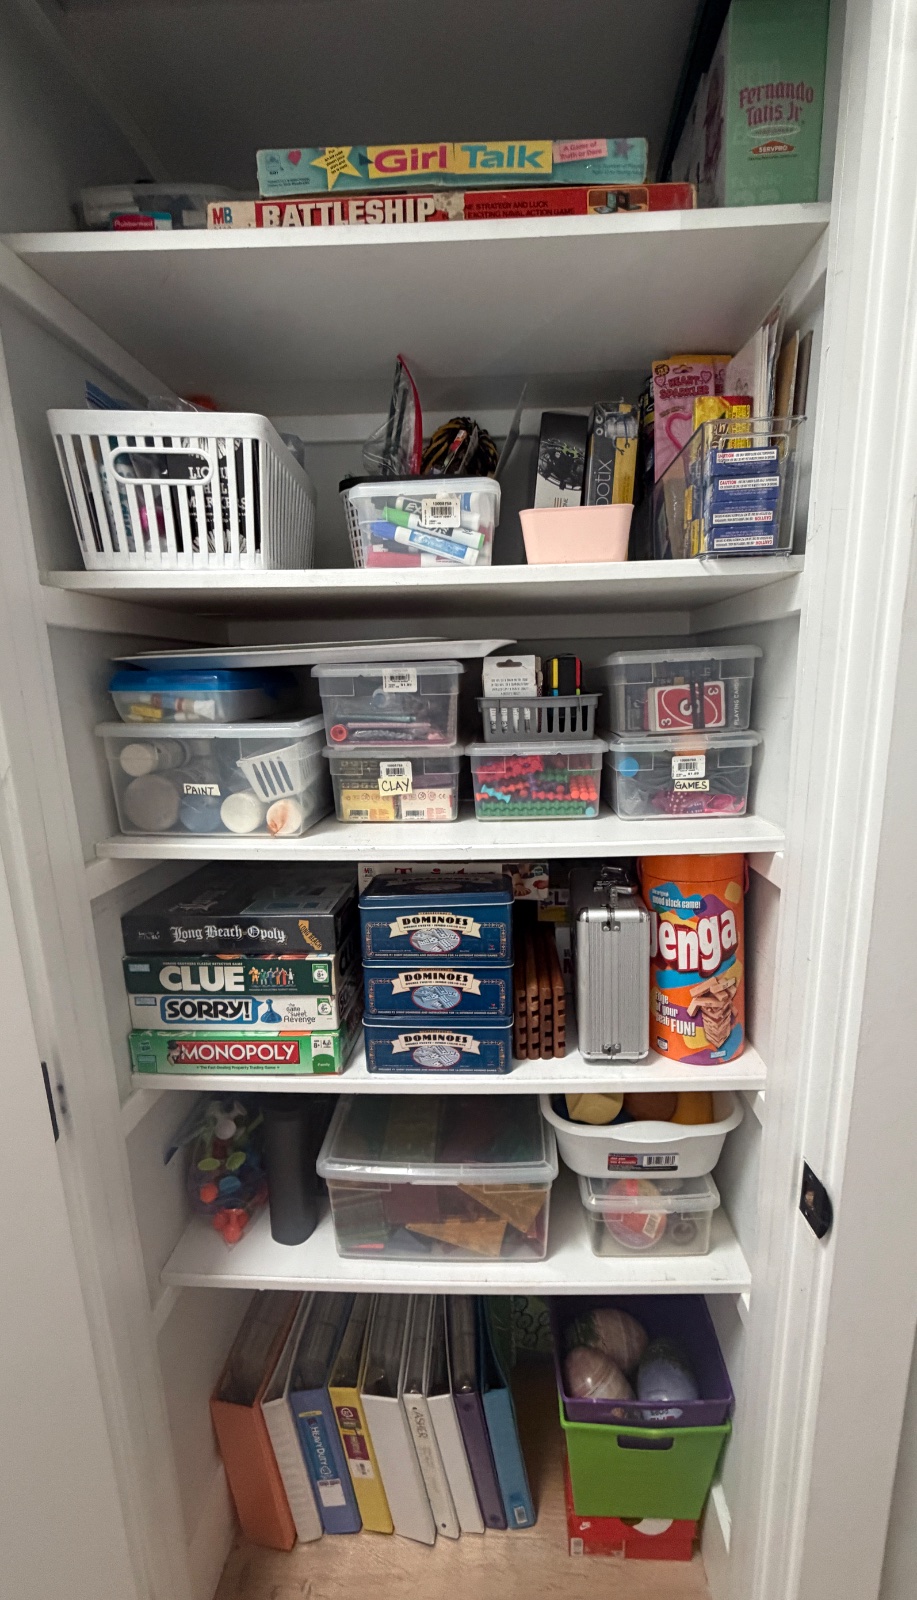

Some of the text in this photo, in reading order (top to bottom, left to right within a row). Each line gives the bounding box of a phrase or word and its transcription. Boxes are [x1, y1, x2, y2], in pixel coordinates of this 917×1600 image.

[739, 81, 814, 108] Fernando
[746, 104, 783, 126] Tatis
[570, 143, 588, 151] Game
[758, 145, 788, 153] SERVPRO
[374, 145, 447, 173] Girl
[461, 145, 544, 168] Talk
[560, 152, 577, 161] Truth
[587, 148, 603, 157] Dare
[513, 201, 528, 209] AND
[529, 200, 548, 208] LUCK
[212, 207, 233, 224] MB
[262, 198, 436, 228] BATTLESHIP
[114, 219, 153, 228] Rubbermaid
[668, 375, 701, 388] HEART
[659, 386, 709, 399] SPARKLER
[185, 785, 214, 795] PAINT
[381, 778, 410, 792] CLAY
[674, 781, 708, 790] GAMES
[402, 915, 468, 926] DOMINOES
[170, 926, 203, 943] Long
[308, 934, 322, 949] BEACH
[159, 965, 245, 992] CLUE
[404, 972, 469, 982] DOMINOES
[166, 1001, 250, 1019] SORRY!
[662, 1005, 678, 1018] your
[284, 1015, 316, 1024] Revenge
[655, 1013, 696, 1036] seat FUN!
[403, 1034, 468, 1044] DOMINOES
[180, 1042, 295, 1061] MONOPOLY
[413, 1409, 428, 1439] ASHER
[310, 1426, 328, 1466] HEAVY DUTY
